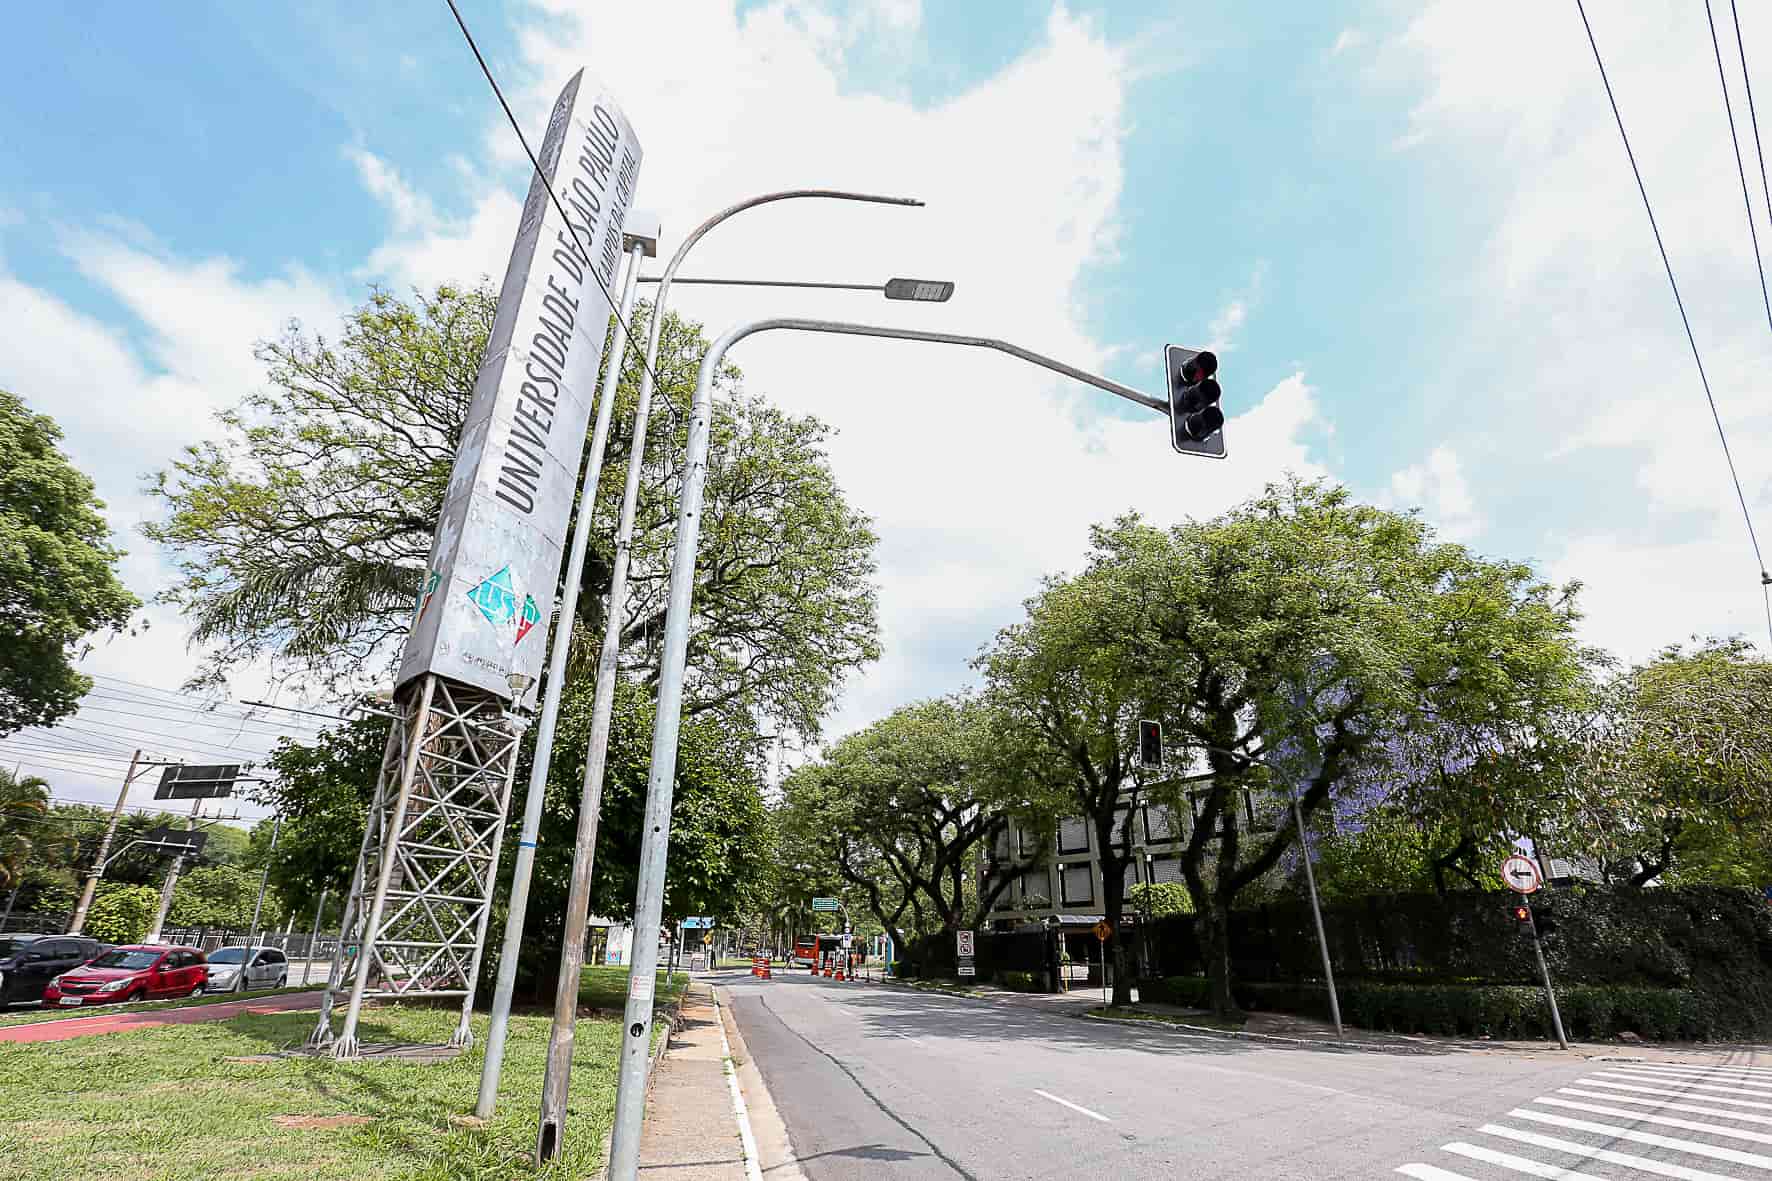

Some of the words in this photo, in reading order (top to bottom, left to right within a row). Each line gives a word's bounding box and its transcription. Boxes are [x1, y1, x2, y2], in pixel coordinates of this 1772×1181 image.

[578, 103, 619, 193] PAULO
[615, 144, 637, 208] CAPITAL
[561, 176, 601, 246] SÃO
[610, 201, 625, 231] DA
[552, 229, 588, 287] DE
[598, 219, 621, 288] CAMPUS
[495, 274, 580, 514] UNIVERSIDADE
